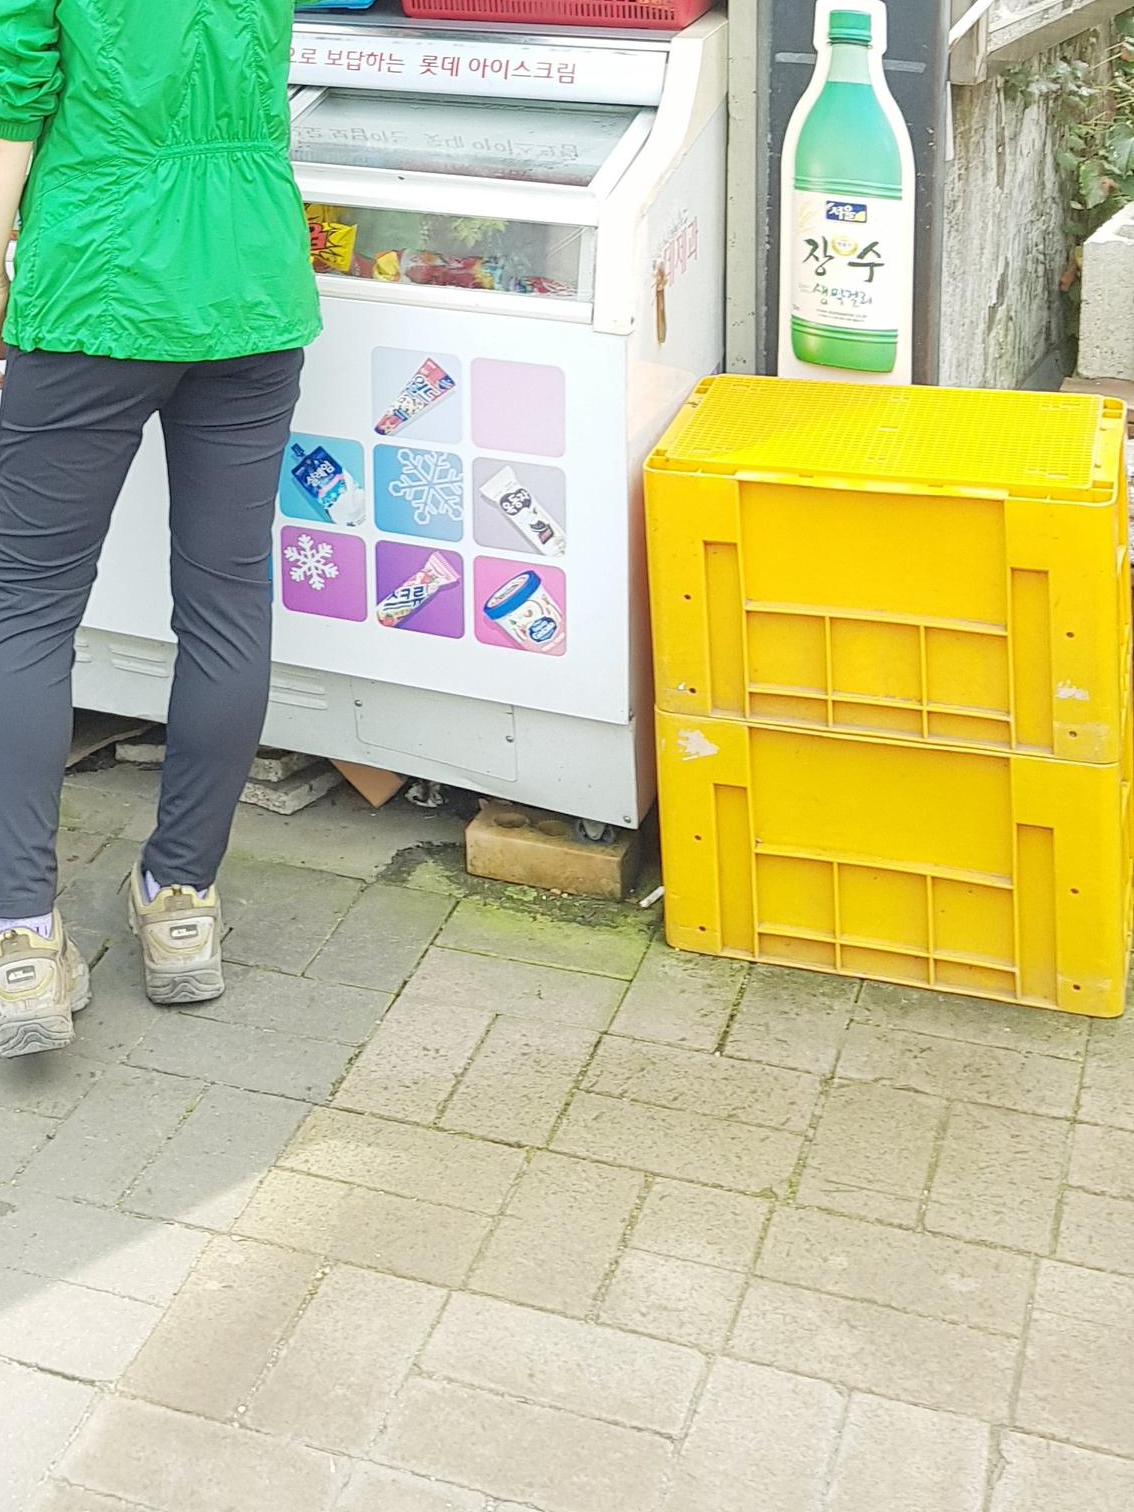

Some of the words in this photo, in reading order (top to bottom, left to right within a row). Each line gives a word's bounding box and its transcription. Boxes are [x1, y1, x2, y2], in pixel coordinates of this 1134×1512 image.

[325, 48, 405, 74] 보답하는
[419, 54, 460, 78] 롯데
[468, 57, 577, 85] 아이스크림
[828, 204, 856, 221] 서울
[802, 235, 885, 283] 장수
[812, 283, 873, 308] 생막걸리
[502, 489, 531, 514] 옥동자
